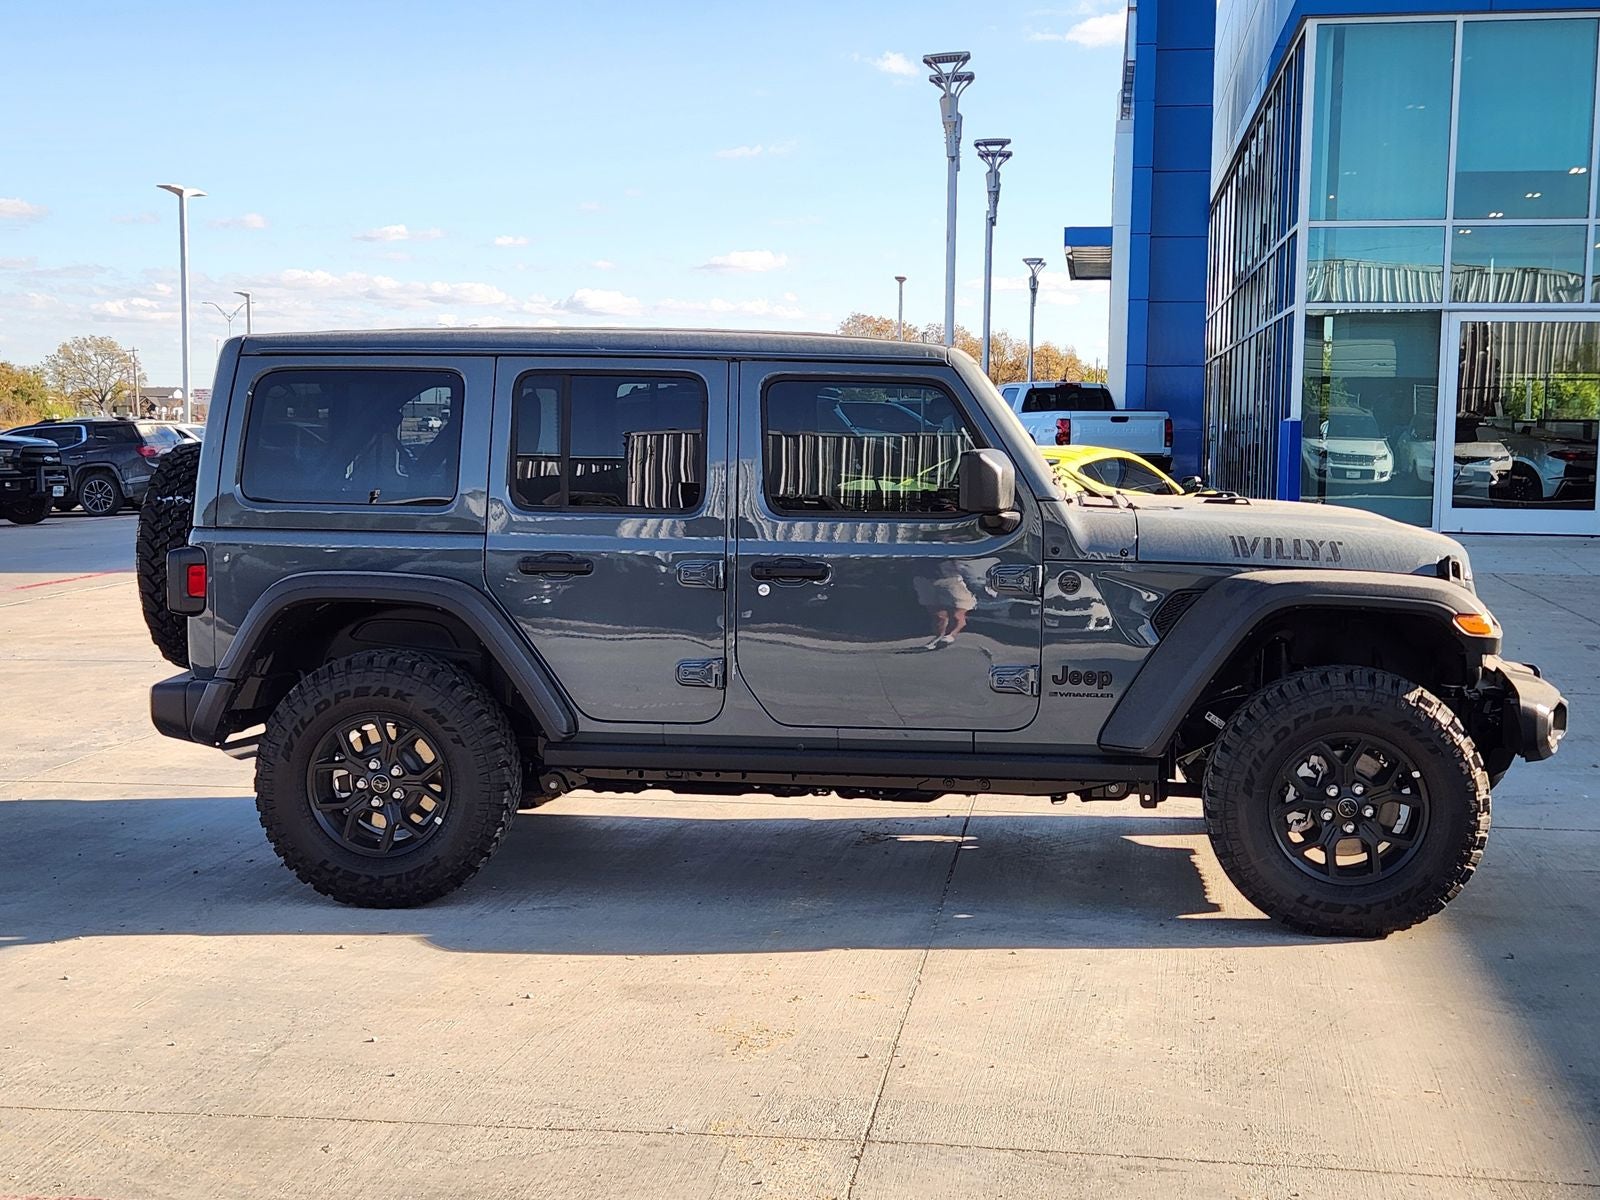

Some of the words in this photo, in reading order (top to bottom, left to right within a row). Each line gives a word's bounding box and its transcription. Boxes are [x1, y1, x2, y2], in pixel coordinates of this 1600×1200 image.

[1229, 535, 1343, 562] WILLYS
[1051, 665, 1113, 690] Jeep
[1059, 691, 1114, 699] WRANGLER
[281, 686, 414, 762] WILDPEAK
[1243, 705, 1383, 796] WILDPEAK
